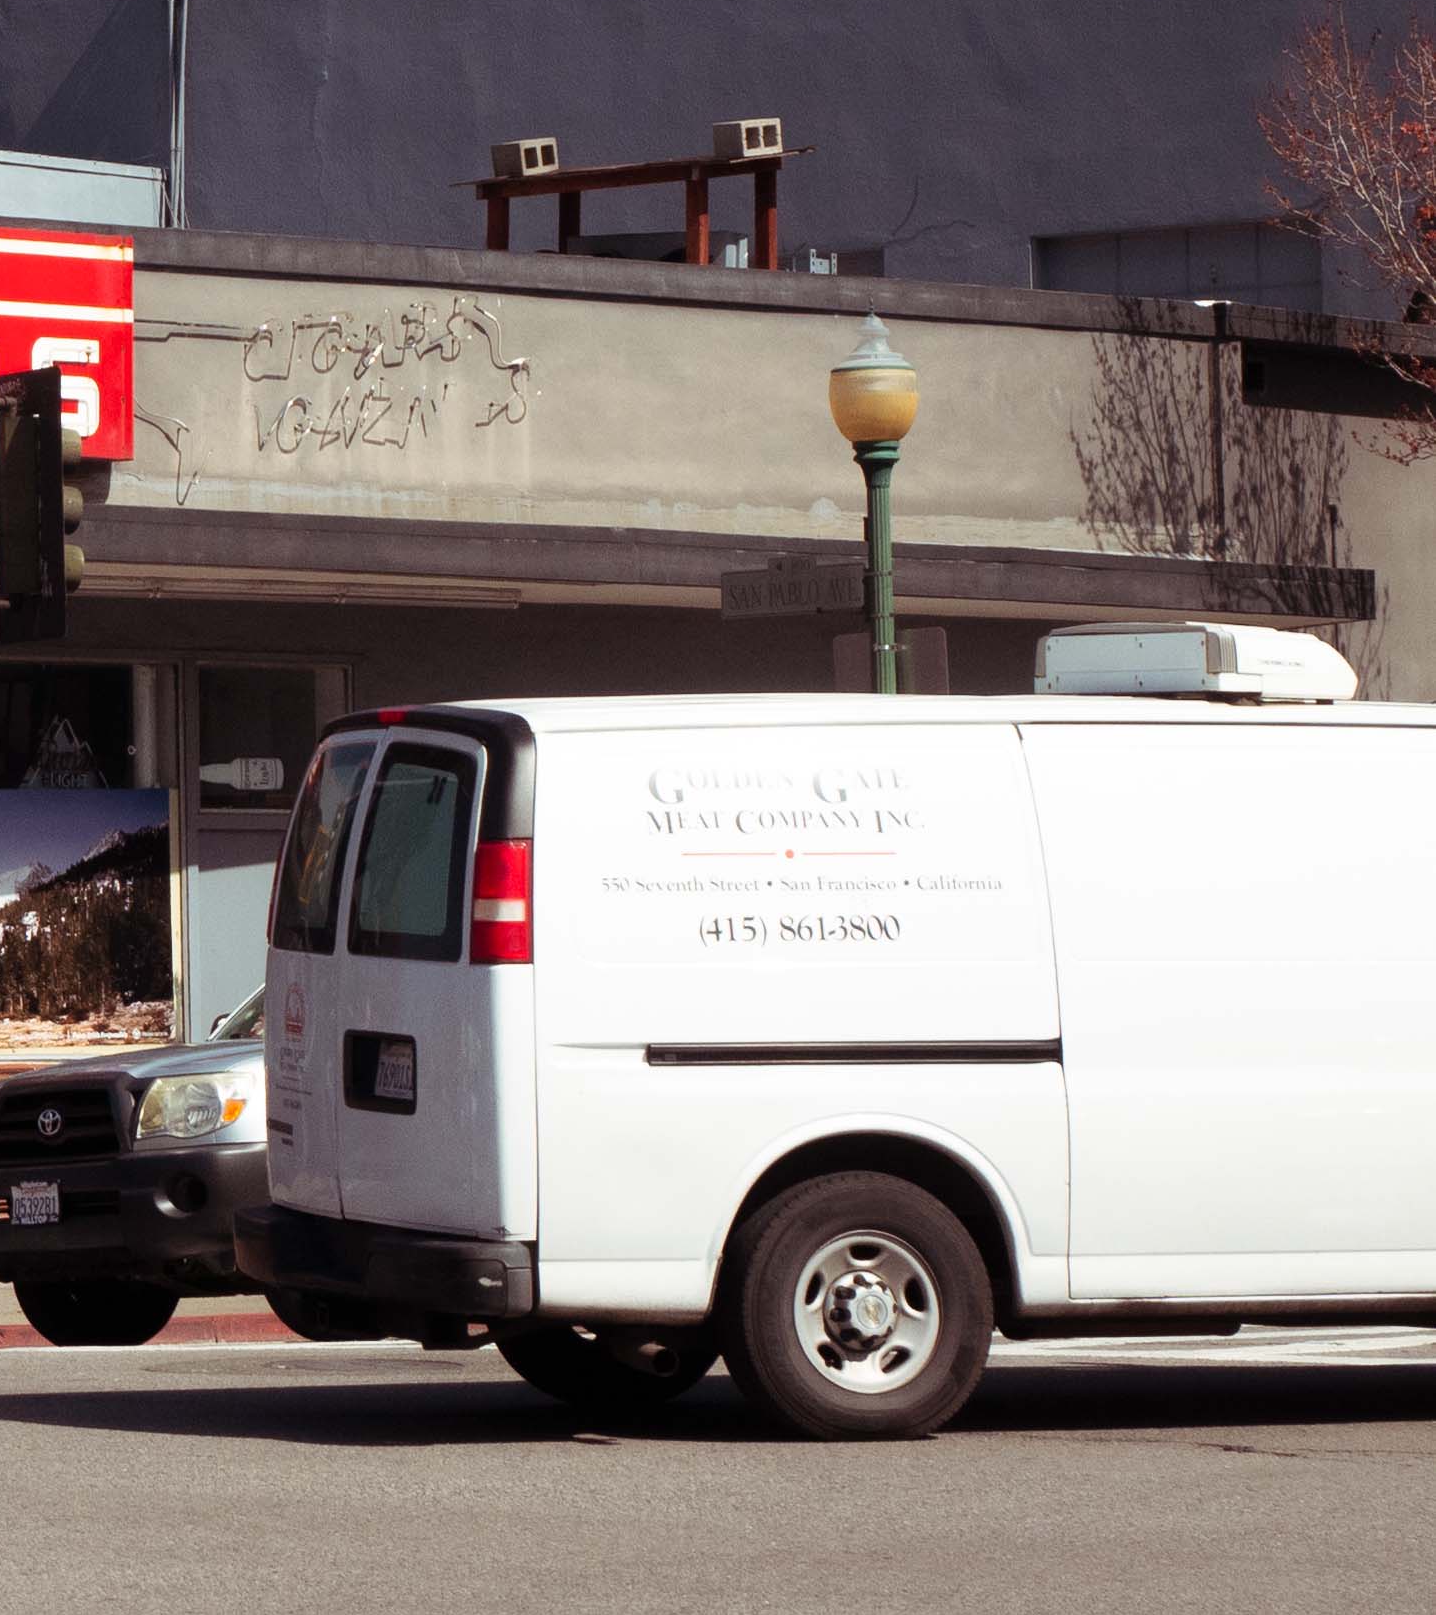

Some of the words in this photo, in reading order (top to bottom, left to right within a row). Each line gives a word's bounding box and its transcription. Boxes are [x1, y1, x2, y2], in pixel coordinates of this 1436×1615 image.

[645, 809, 724, 836] MEAT
[735, 809, 864, 836] COMPANY
[601, 877, 629, 892] 550
[634, 875, 705, 892] Seventh
[709, 875, 760, 892] Street
[779, 876, 811, 892] San
[817, 875, 897, 892] Francisco
[916, 875, 1003, 892] California
[698, 914, 768, 948] (415)
[779, 914, 902, 943] 861-3800
